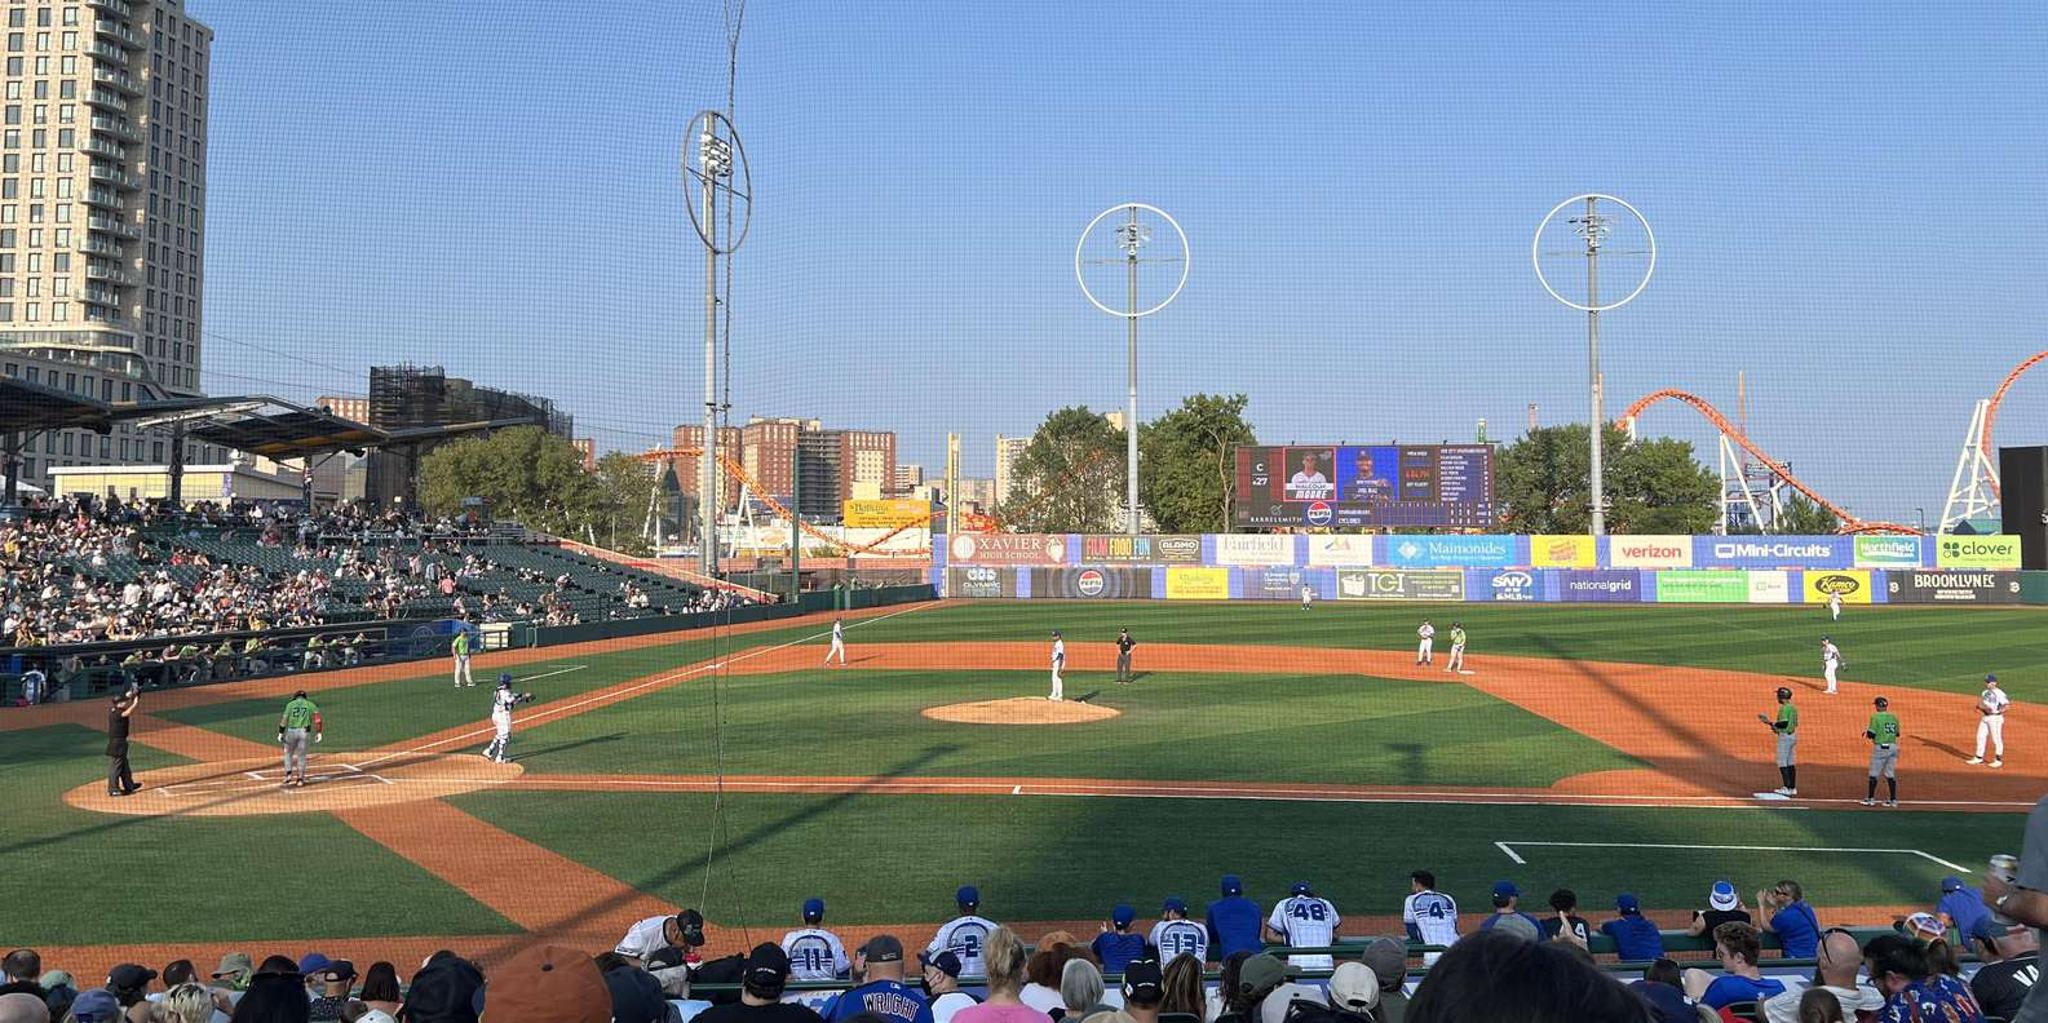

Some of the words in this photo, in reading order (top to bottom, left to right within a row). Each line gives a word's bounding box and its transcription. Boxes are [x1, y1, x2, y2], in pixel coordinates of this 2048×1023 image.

[980, 538, 1042, 550] XAVIER
[1087, 538, 1108, 556] FILM
[1109, 538, 1132, 556] FOOD
[1133, 538, 1151, 556] FUN
[1162, 541, 1196, 549] ALAMO
[1224, 536, 1284, 551] Fairfield
[1428, 542, 1507, 555] Maimonides
[1622, 543, 1682, 558] verizon
[1736, 543, 1831, 558] Mini-Circuits
[1862, 541, 1915, 553] Northfield
[1961, 541, 2013, 556] clover
[980, 551, 1002, 559] HIGH
[1006, 551, 1040, 559] SCHOOL
[1080, 579, 1102, 587] PEPSI
[1491, 576, 1528, 588] SNY
[1569, 580, 1632, 592] nationalgrid
[1914, 574, 1981, 588] BROOKLYN
[292, 707, 307, 718] 27
[1293, 902, 1326, 922] 48
[1429, 901, 1445, 920] 4
[964, 934, 979, 958] 2
[1171, 932, 1198, 954] 13
[803, 947, 822, 971] 11
[862, 991, 920, 1023] WRIGHT
